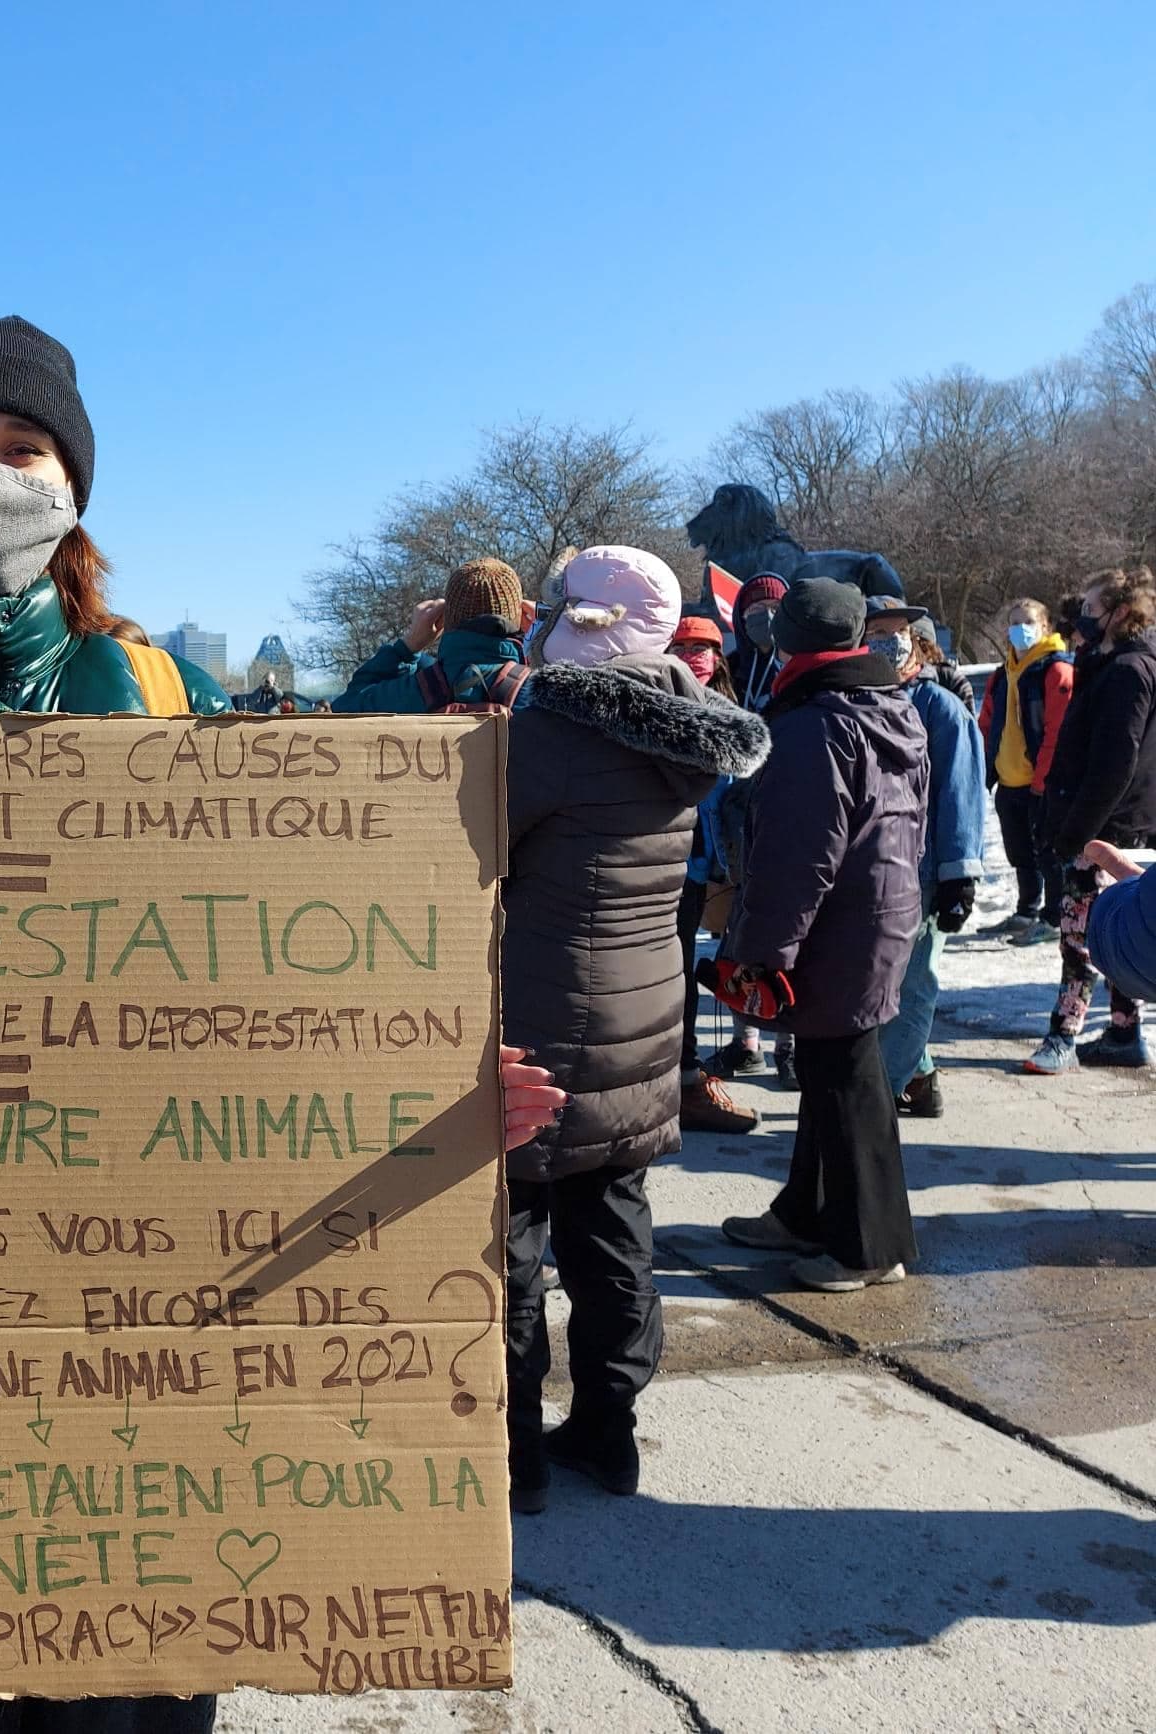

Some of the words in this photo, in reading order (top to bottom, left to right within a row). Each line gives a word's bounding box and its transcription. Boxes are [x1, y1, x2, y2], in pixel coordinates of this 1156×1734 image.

[127, 729, 341, 783] CAUSES
[375, 734, 451, 782] DU
[57, 796, 393, 840] CLIMATIQUE
[42, 996, 99, 1047] LA
[119, 996, 462, 1052] DEFORESTATION
[140, 1092, 435, 1163] ANIMALE
[38, 1211, 176, 1258] VOUS
[218, 1209, 281, 1256] ICI
[322, 1210, 379, 1252] SI
[82, 1284, 259, 1334] ENCORE
[296, 1286, 390, 1327] DES
[57, 1347, 221, 1401] ANIMALE
[233, 1344, 297, 1397] EN
[252, 1453, 404, 1512] POUR
[425, 1456, 487, 1512] LA
[207, 1593, 311, 1655] SUR
[326, 1585, 511, 1643] NETFLIX
[300, 1645, 513, 1694] YOUTUBE
